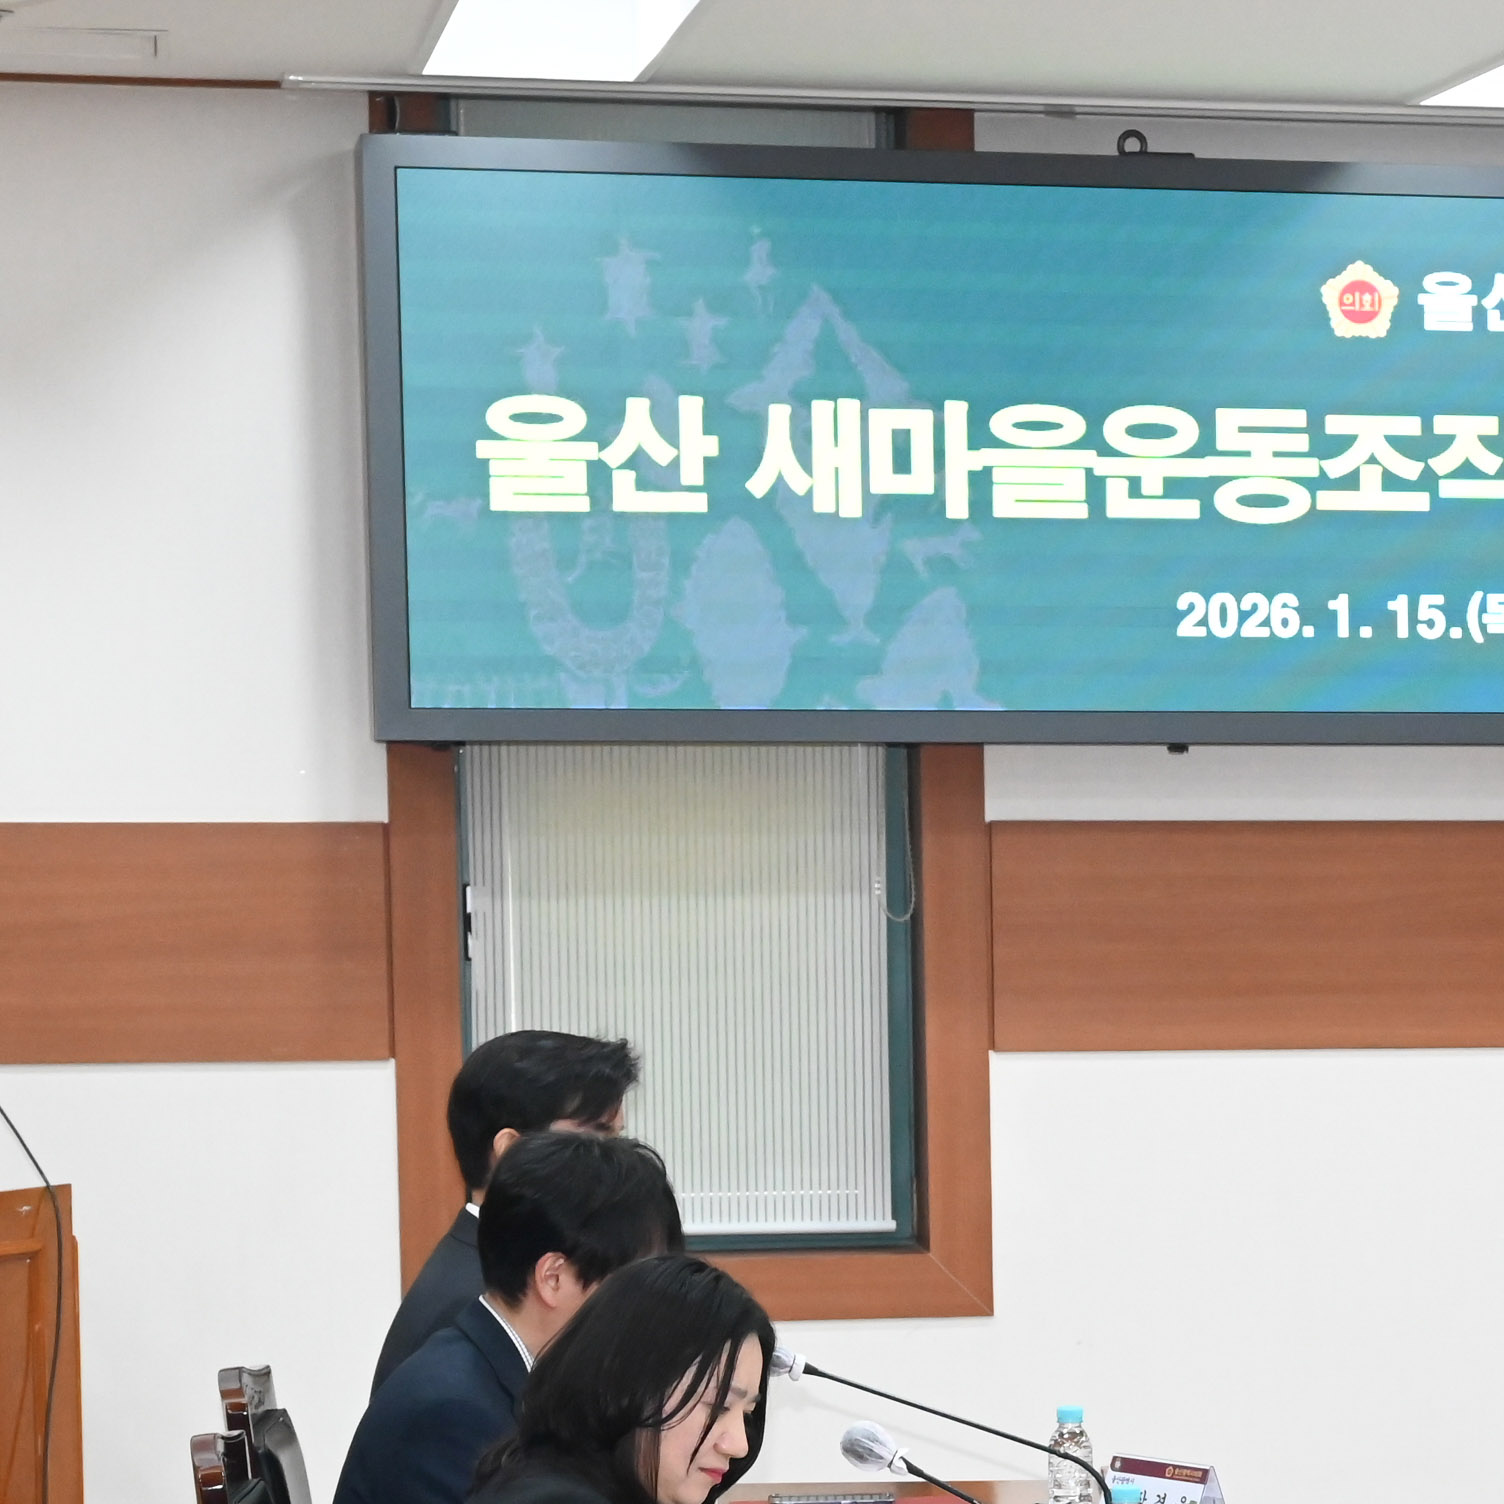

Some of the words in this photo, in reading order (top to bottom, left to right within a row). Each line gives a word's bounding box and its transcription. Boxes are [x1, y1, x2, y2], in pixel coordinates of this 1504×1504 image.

[1341, 291, 1379, 312] 의회
[475, 393, 719, 513] 울산
[1176, 591, 1315, 639] 2026.
[1327, 593, 1373, 639] 1.
